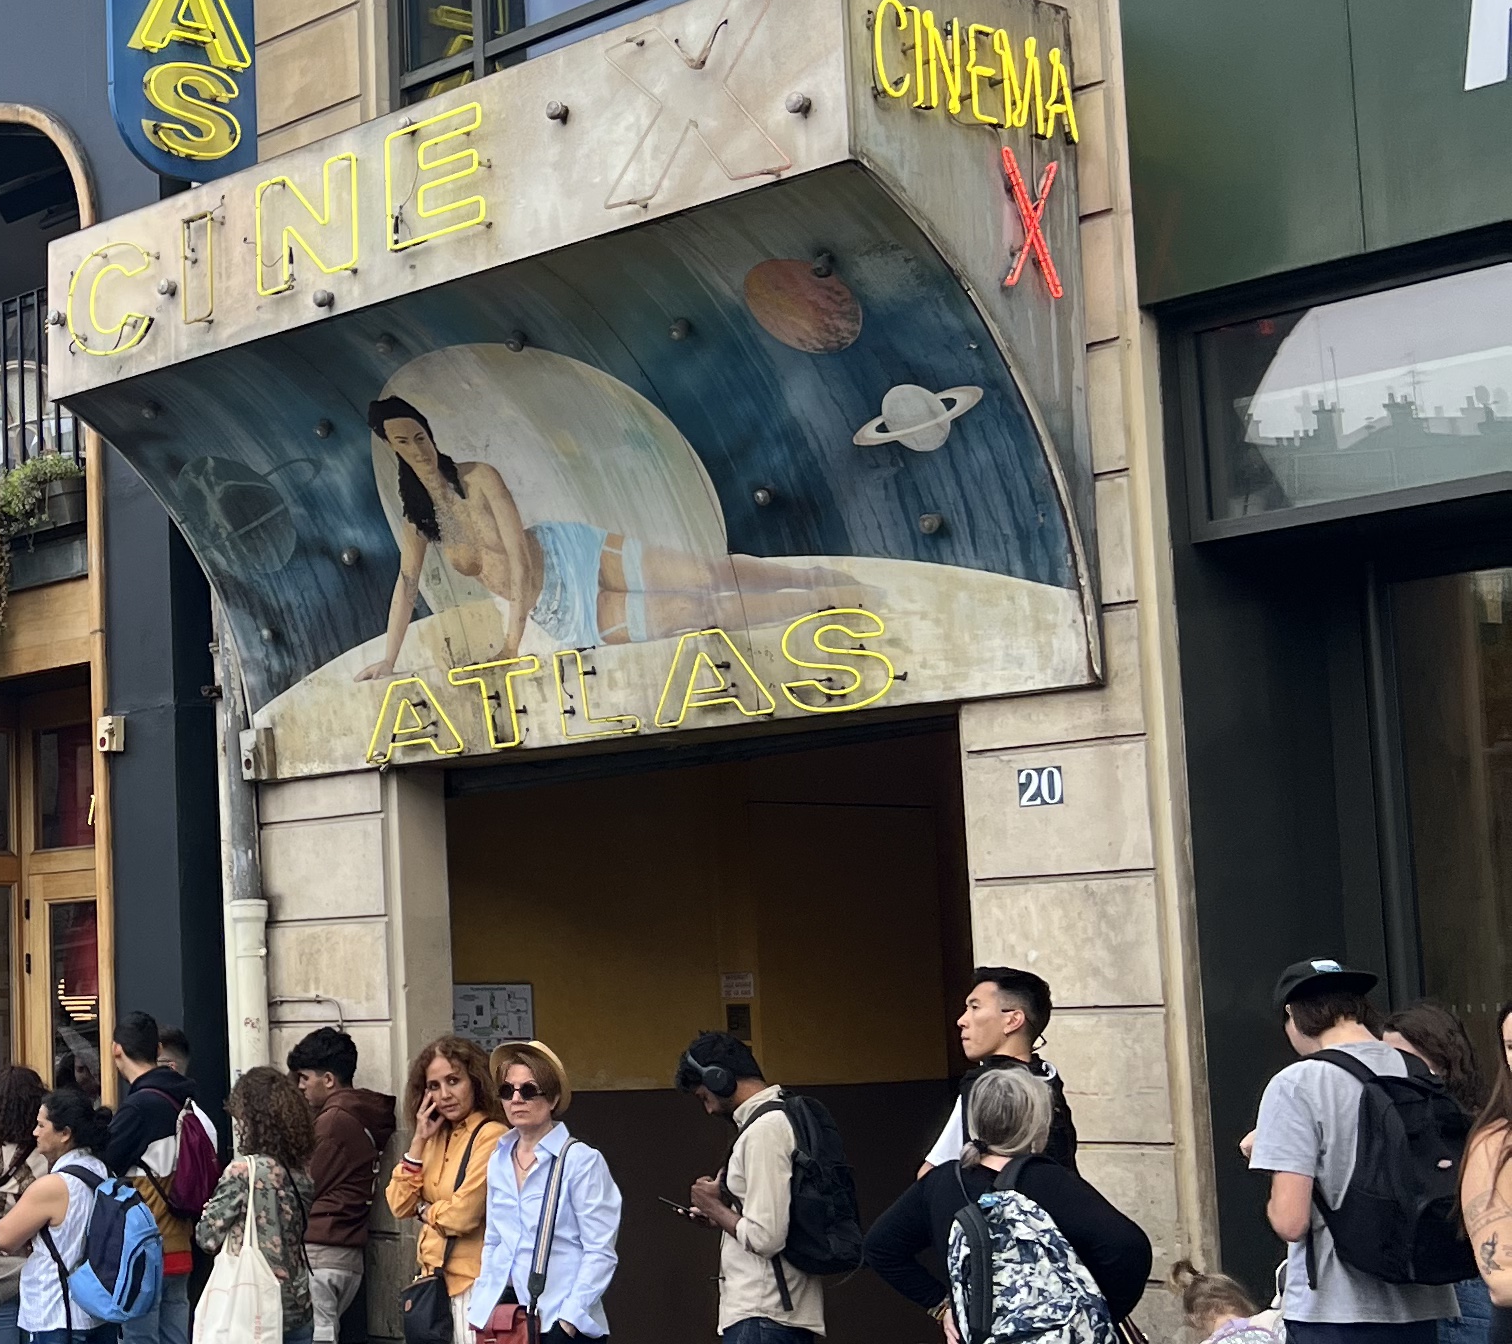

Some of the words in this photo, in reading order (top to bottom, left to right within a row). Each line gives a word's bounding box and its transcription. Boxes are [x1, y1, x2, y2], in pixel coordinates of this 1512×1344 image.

[66, 101, 487, 357] CINE
[1001, 146, 1064, 299] X
[365, 607, 895, 764] ATLAS
[1018, 766, 1063, 806] 20
